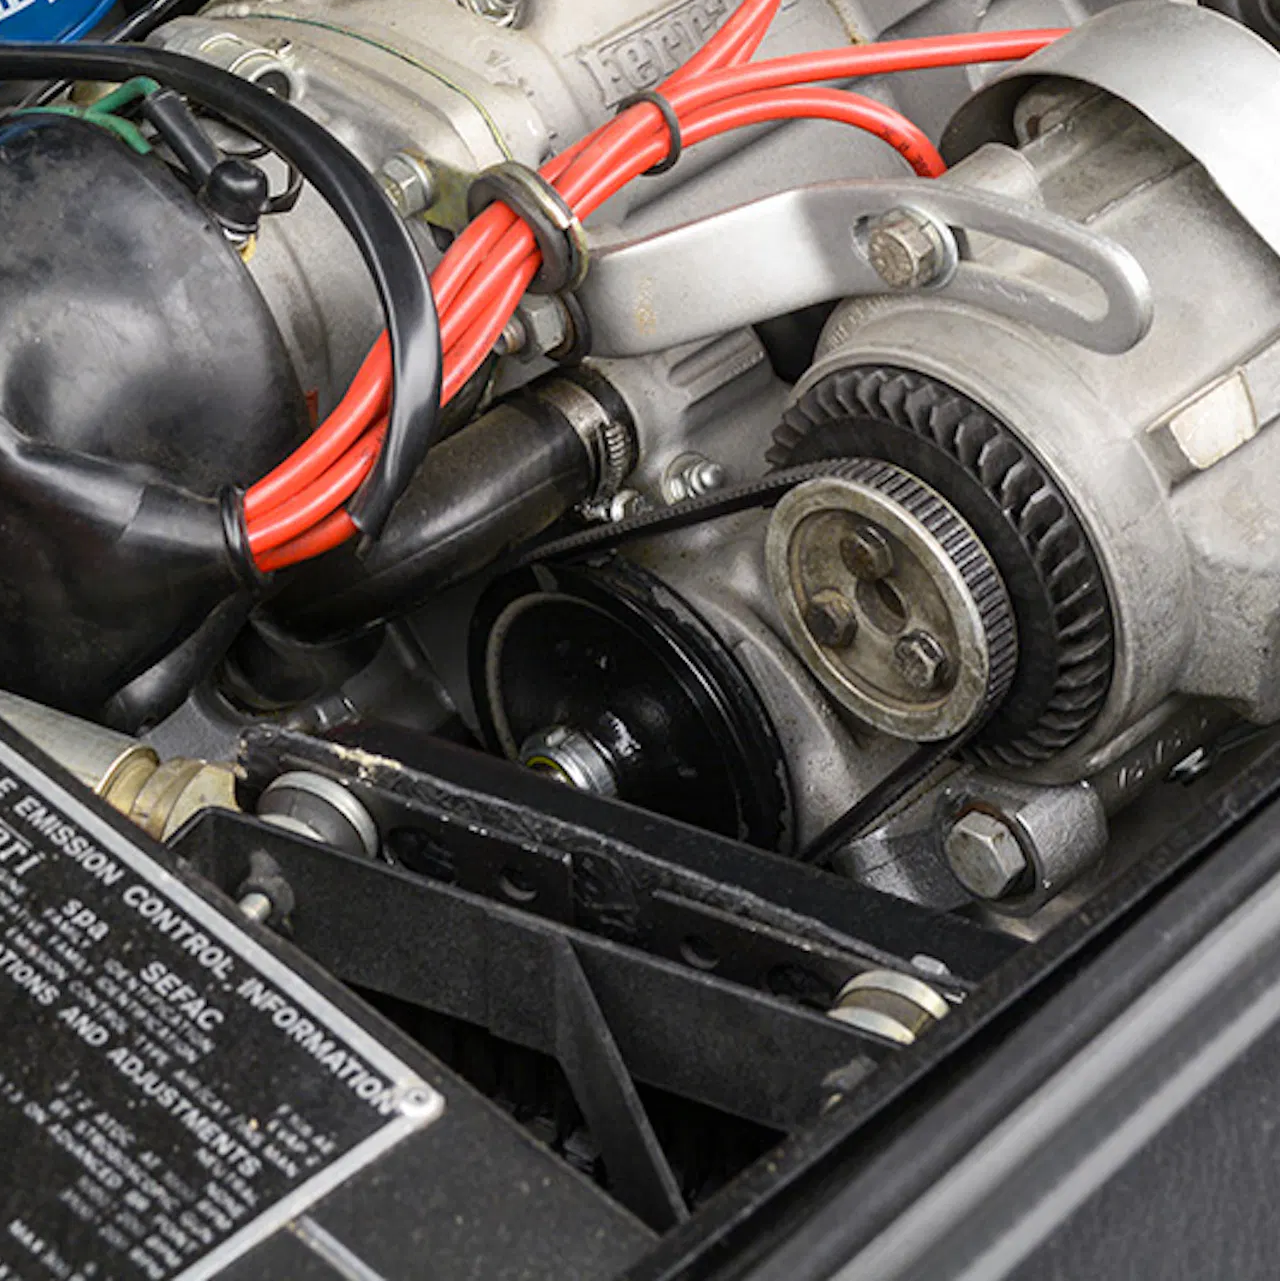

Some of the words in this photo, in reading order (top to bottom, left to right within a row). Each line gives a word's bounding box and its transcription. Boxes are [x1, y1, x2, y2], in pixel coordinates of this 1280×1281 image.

[10, 794, 127, 887] EMISSION
[117, 881, 241, 981] CONTROL
[232, 975, 406, 1116] INFORMATION
[56, 897, 114, 941] spa
[136, 959, 228, 1032] SEFAC
[54, 1002, 114, 1049] AND
[102, 1043, 266, 1178] ADJUSTMENTS
